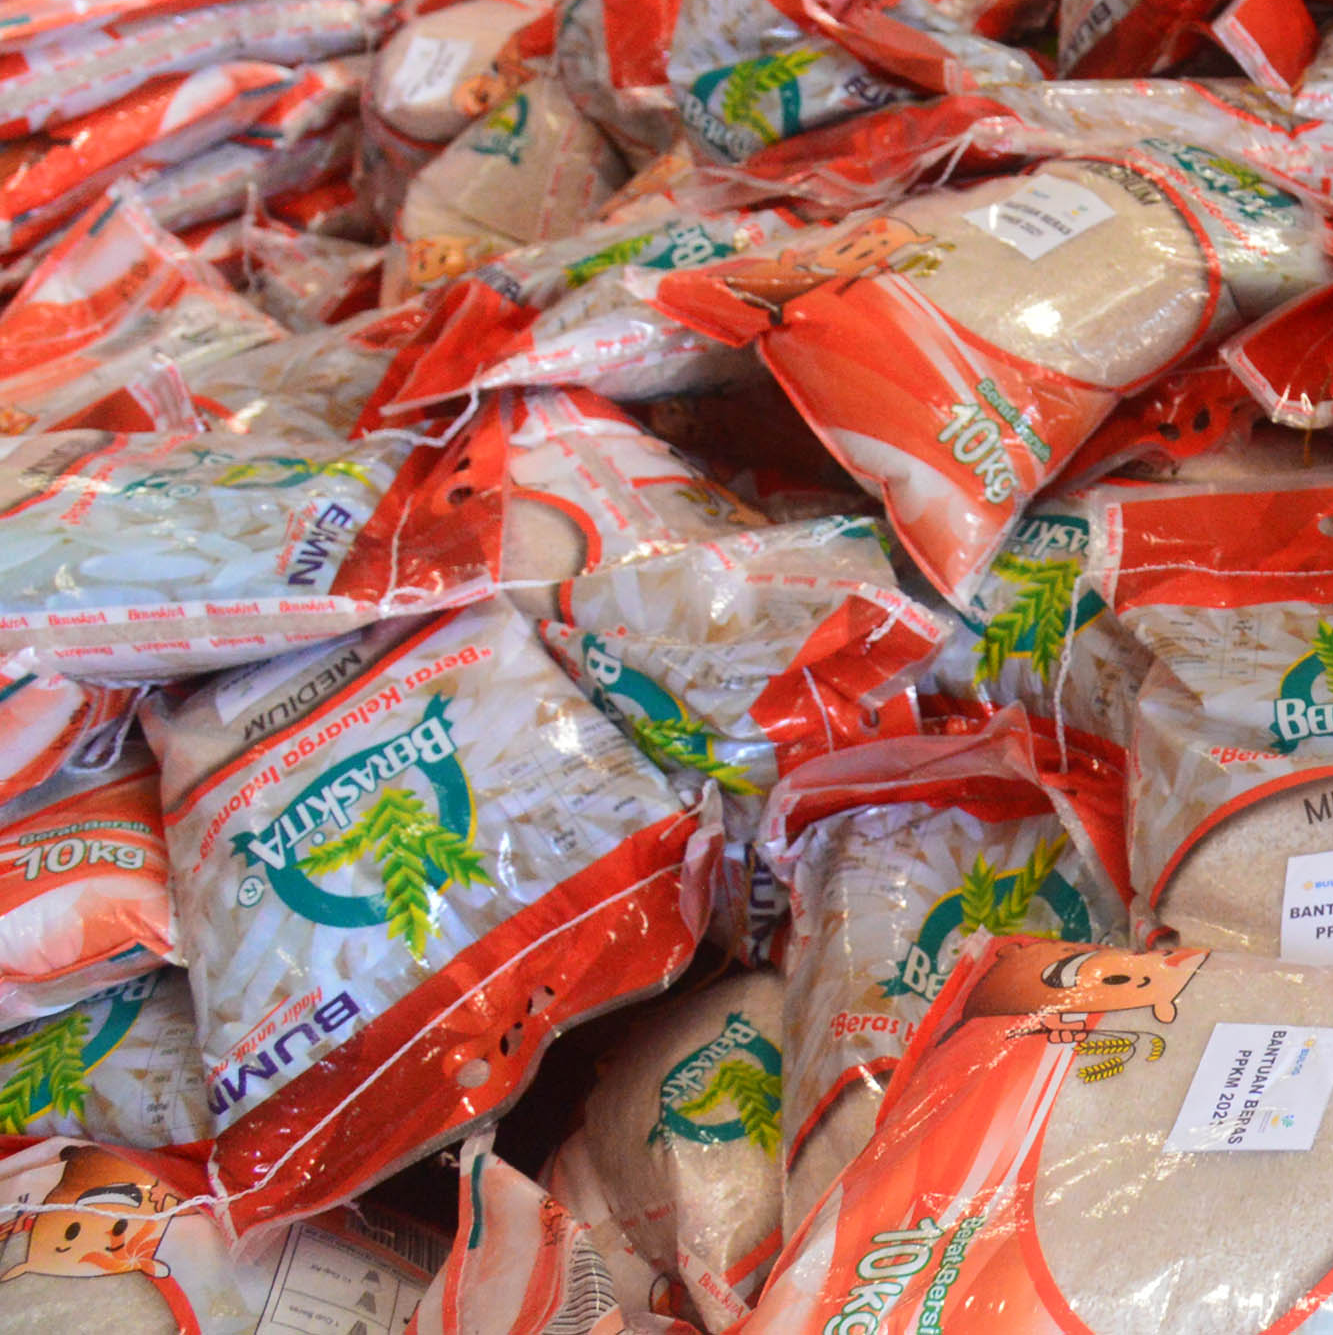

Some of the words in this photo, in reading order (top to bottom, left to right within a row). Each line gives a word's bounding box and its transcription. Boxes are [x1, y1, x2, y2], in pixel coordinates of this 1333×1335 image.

[938, 403, 1019, 504] 10kg
[243, 648, 363, 742] MEDIUM
[282, 685, 402, 769] Keluarga
[13, 837, 148, 882] 10kg
[1223, 1049, 1252, 1089] PPKM
[1248, 1030, 1288, 1095] BANTUAN
[1227, 1099, 1260, 1145] BERAS
[919, 1266, 960, 1335] Bersi
